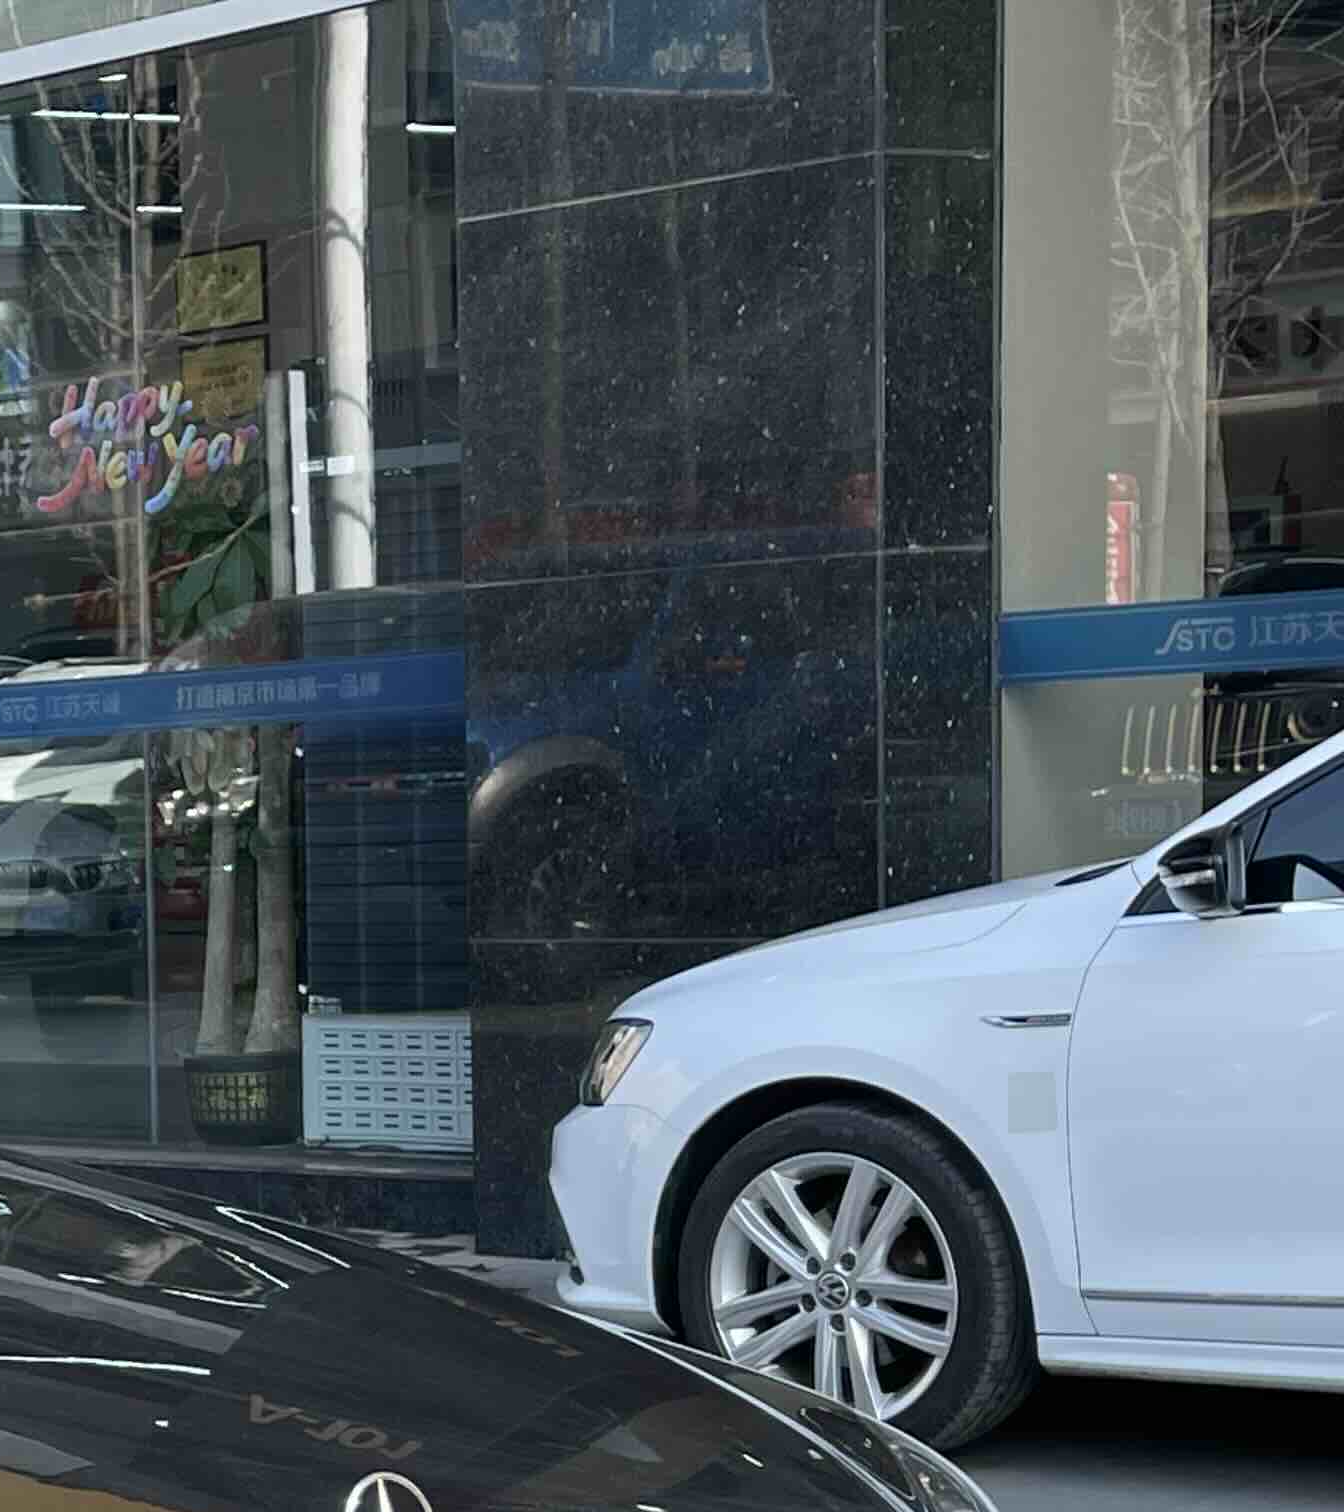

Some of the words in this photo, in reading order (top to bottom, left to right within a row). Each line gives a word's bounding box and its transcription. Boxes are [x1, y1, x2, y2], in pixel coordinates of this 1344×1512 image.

[49, 376, 192, 448] Happy
[37, 440, 159, 513] New
[145, 424, 259, 514] Year
